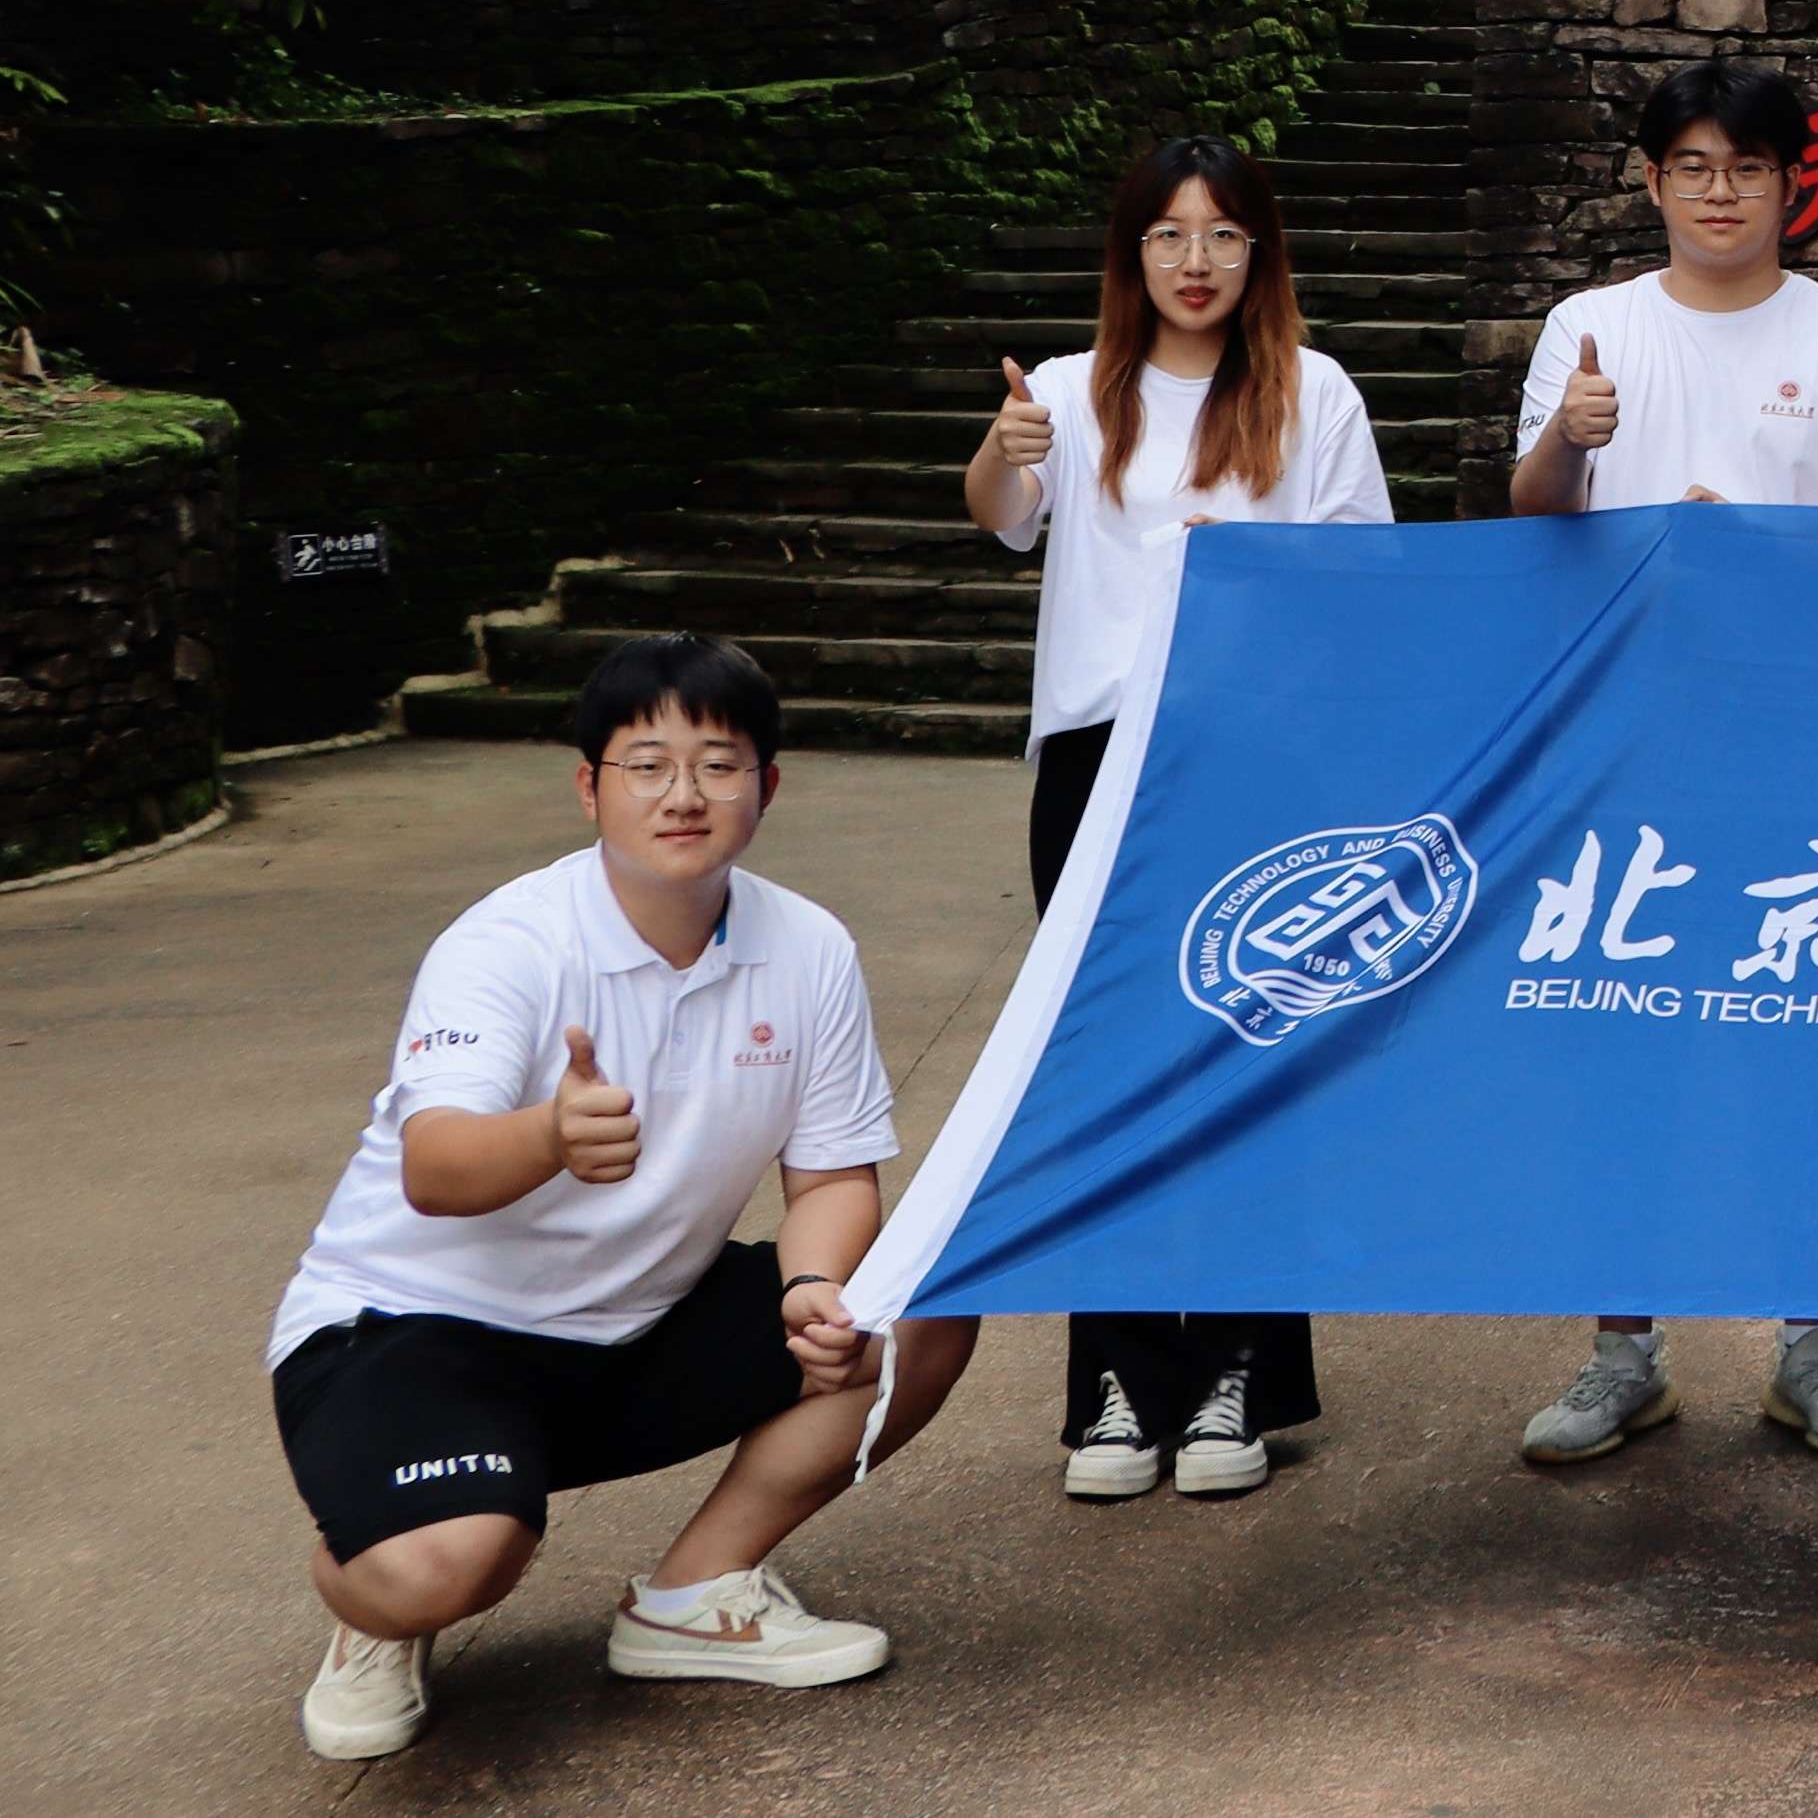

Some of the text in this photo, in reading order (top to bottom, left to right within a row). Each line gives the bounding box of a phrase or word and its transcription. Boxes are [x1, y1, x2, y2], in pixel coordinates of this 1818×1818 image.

[1341, 837, 1387, 857] AND
[1303, 952, 1352, 978] 1950
[1505, 979, 1681, 1017] BEIJING
